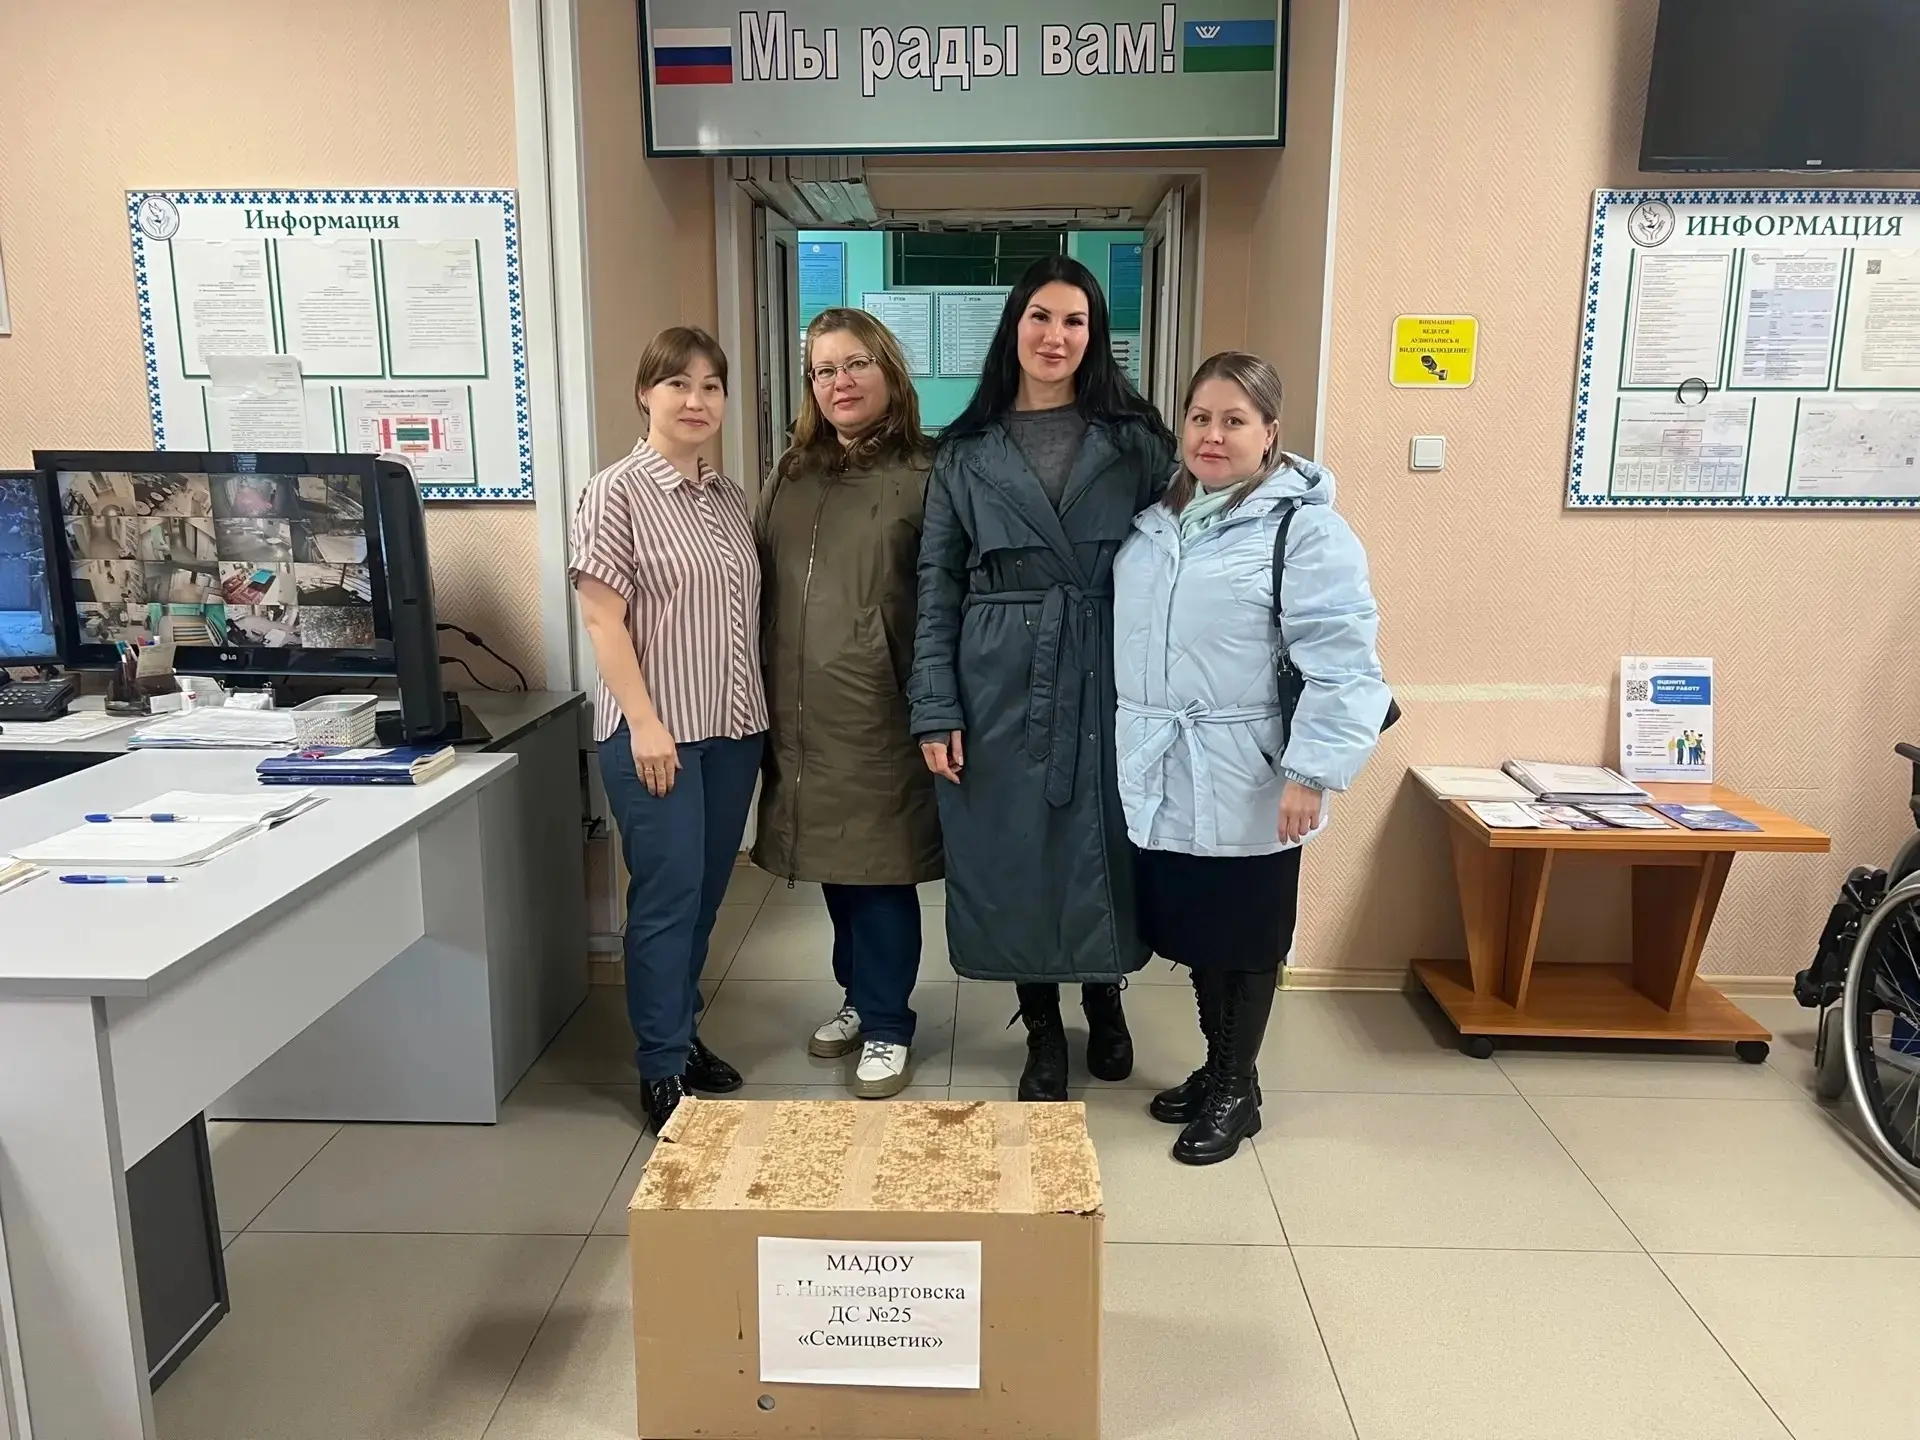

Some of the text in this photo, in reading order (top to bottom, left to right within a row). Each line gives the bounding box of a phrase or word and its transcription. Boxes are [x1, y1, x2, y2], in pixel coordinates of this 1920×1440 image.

[739, 2, 1176, 98] Мы рады вам!
[244, 209, 400, 236] Информация
[1686, 214, 1904, 240] ИНФОРМАЦИЯ
[826, 1254, 915, 1275] МАДОУ
[775, 1279, 966, 1303] г. Нижневартовска
[828, 1305, 912, 1325] ДС №25
[797, 1329, 944, 1349] «Семицветик»
